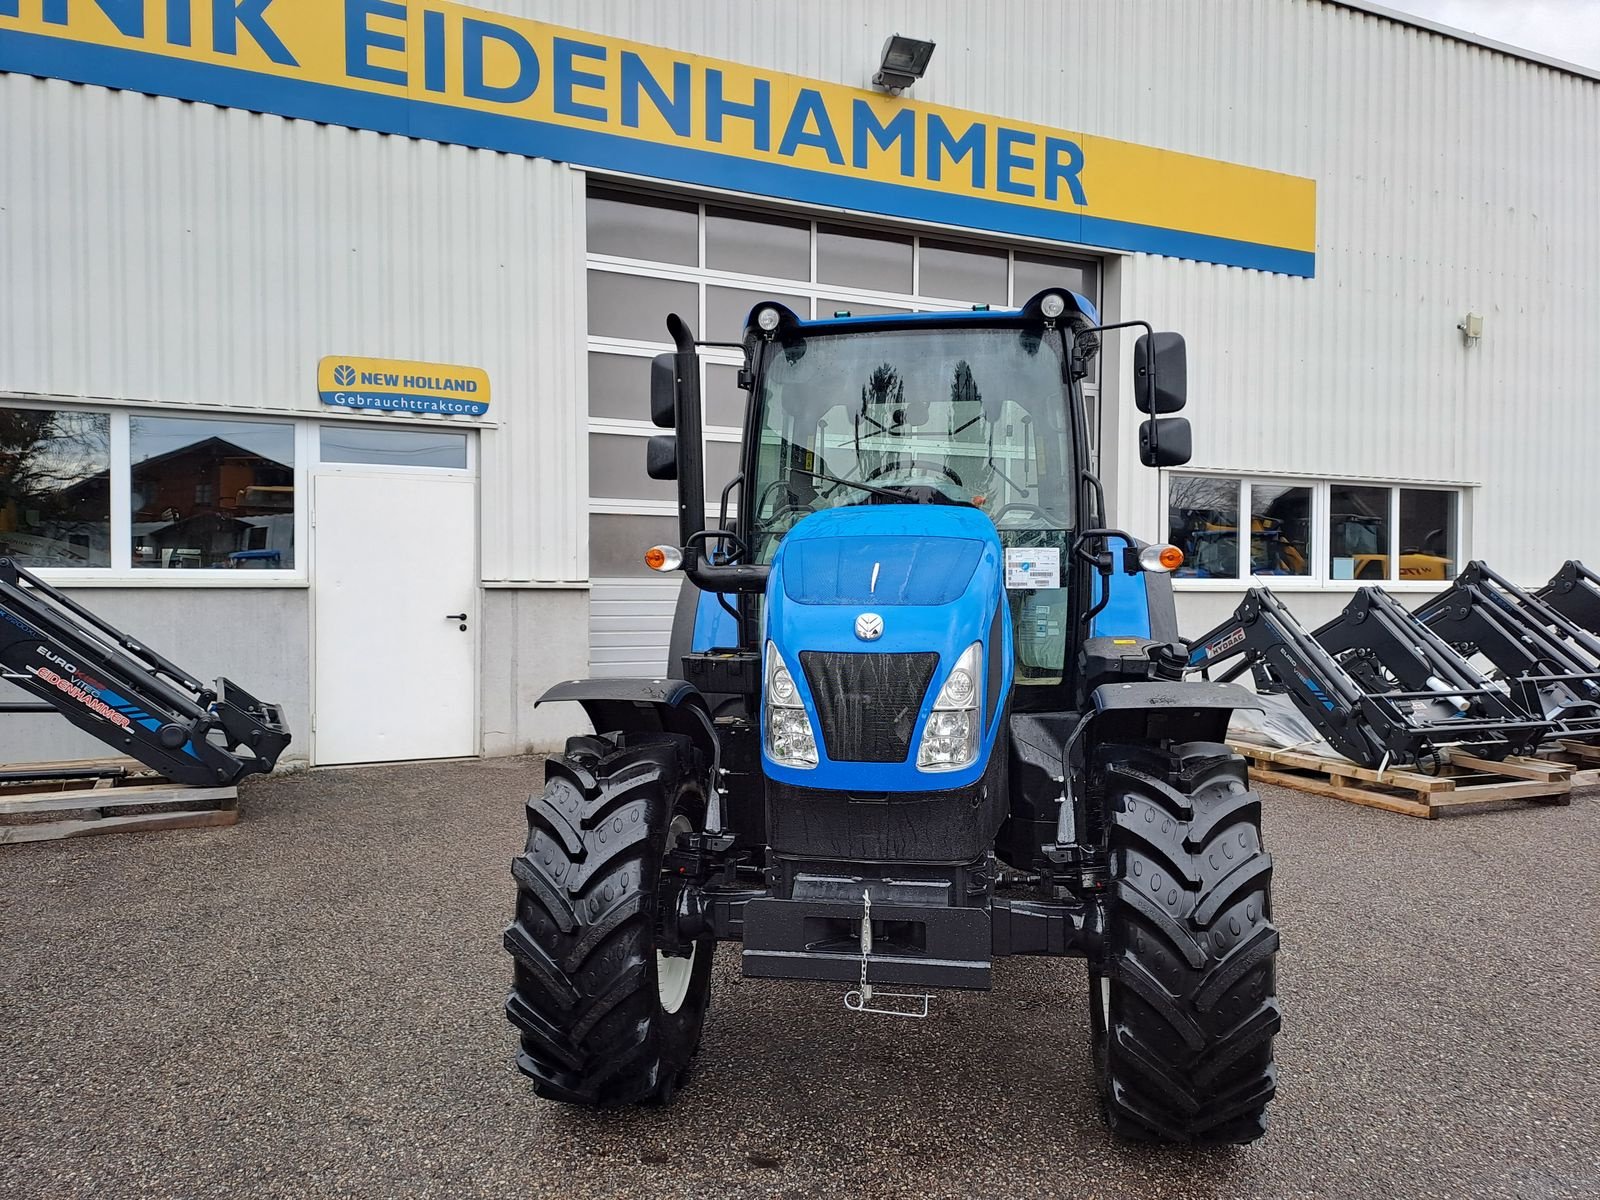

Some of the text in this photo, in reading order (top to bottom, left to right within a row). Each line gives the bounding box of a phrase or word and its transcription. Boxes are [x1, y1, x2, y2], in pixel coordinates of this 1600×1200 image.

[345, 0, 1088, 206] EIDENHAMMER
[361, 372, 477, 393] NEW HOLLAND
[334, 392, 479, 413] Gebrauchttraktore
[1212, 633, 1244, 655] HYDRAC
[36, 666, 131, 728] EIDENHAMMER
